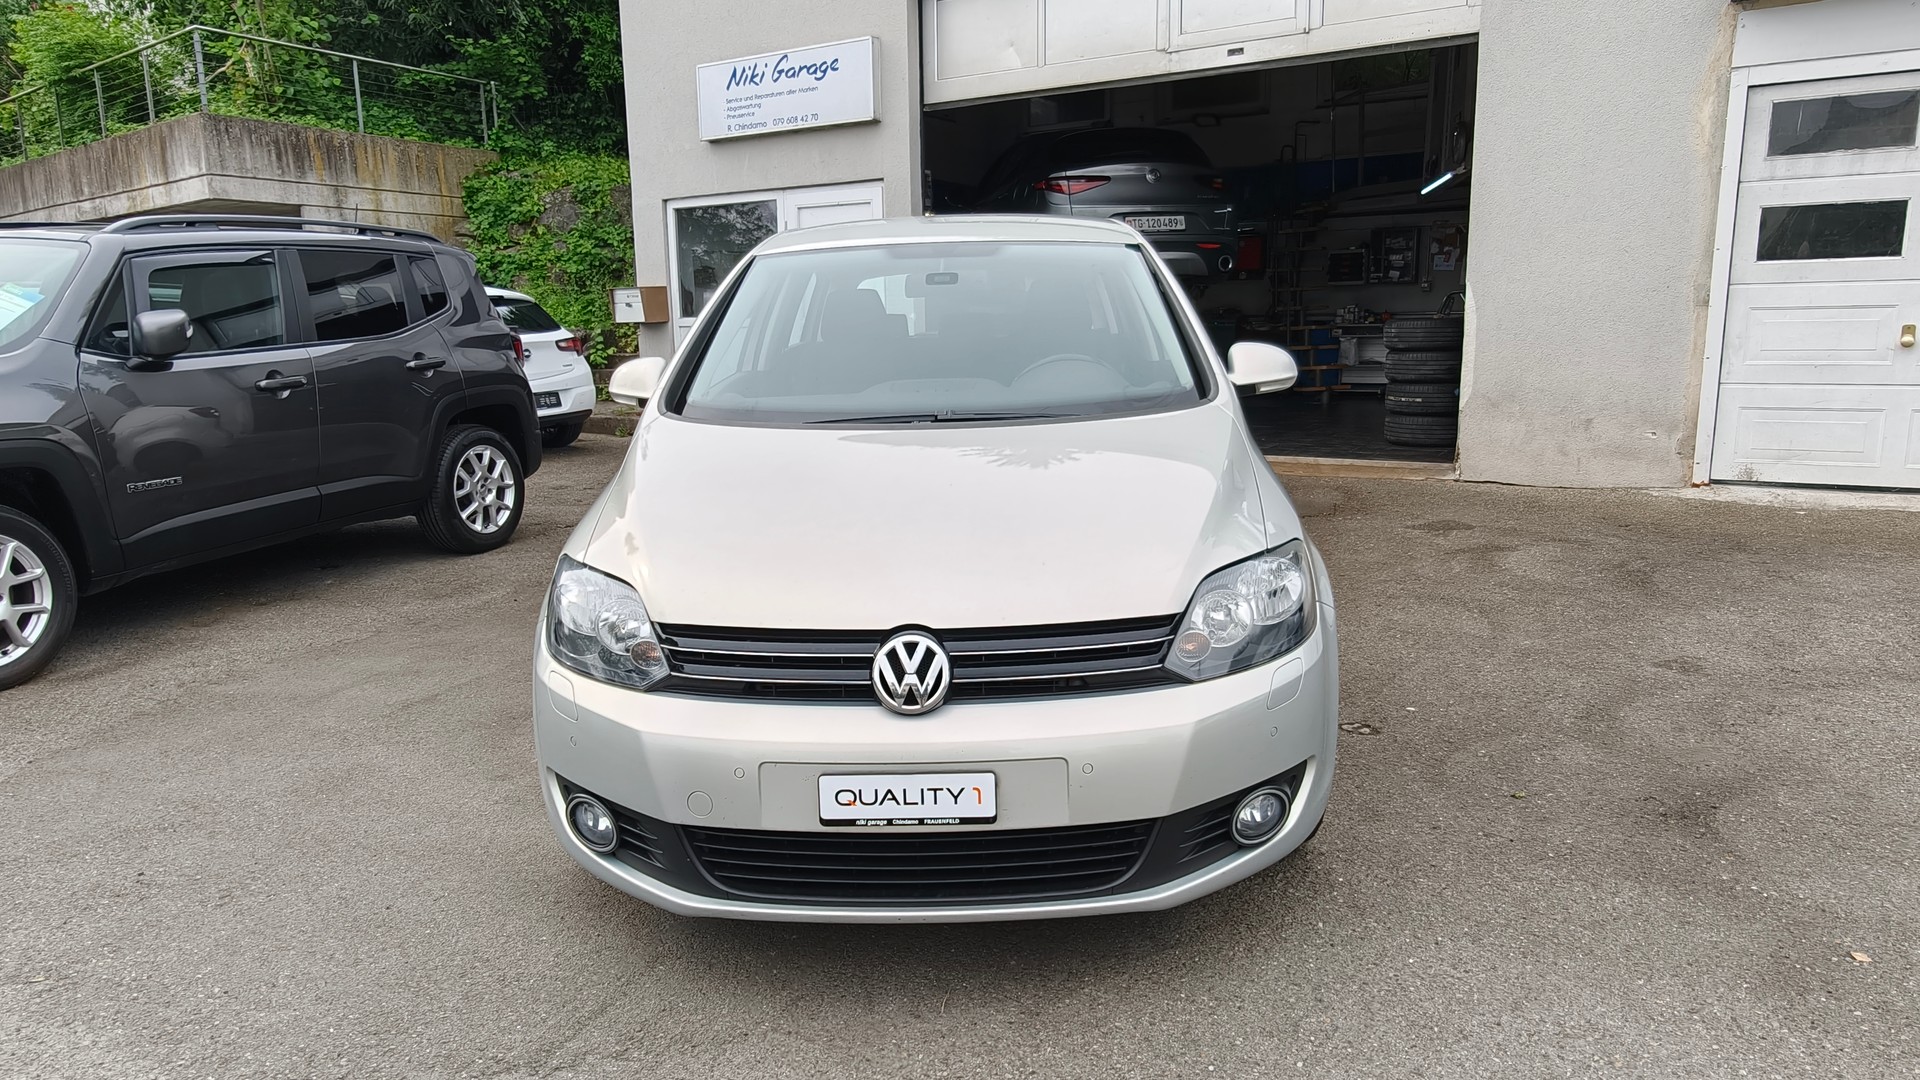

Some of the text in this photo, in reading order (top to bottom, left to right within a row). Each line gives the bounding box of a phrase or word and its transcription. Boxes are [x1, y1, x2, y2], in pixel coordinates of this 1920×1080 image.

[726, 54, 839, 91] Niki Garage
[726, 96, 743, 105] Service
[754, 91, 785, 101] Reparaturen
[797, 86, 818, 94] Marken
[726, 111, 755, 120] Pneuservice
[733, 121, 768, 132] Chindamo
[772, 117, 785, 127] 079
[786, 116, 798, 125] 608
[799, 114, 809, 123] 42
[810, 113, 819, 121] 70
[834, 787, 966, 807] QUALITY
